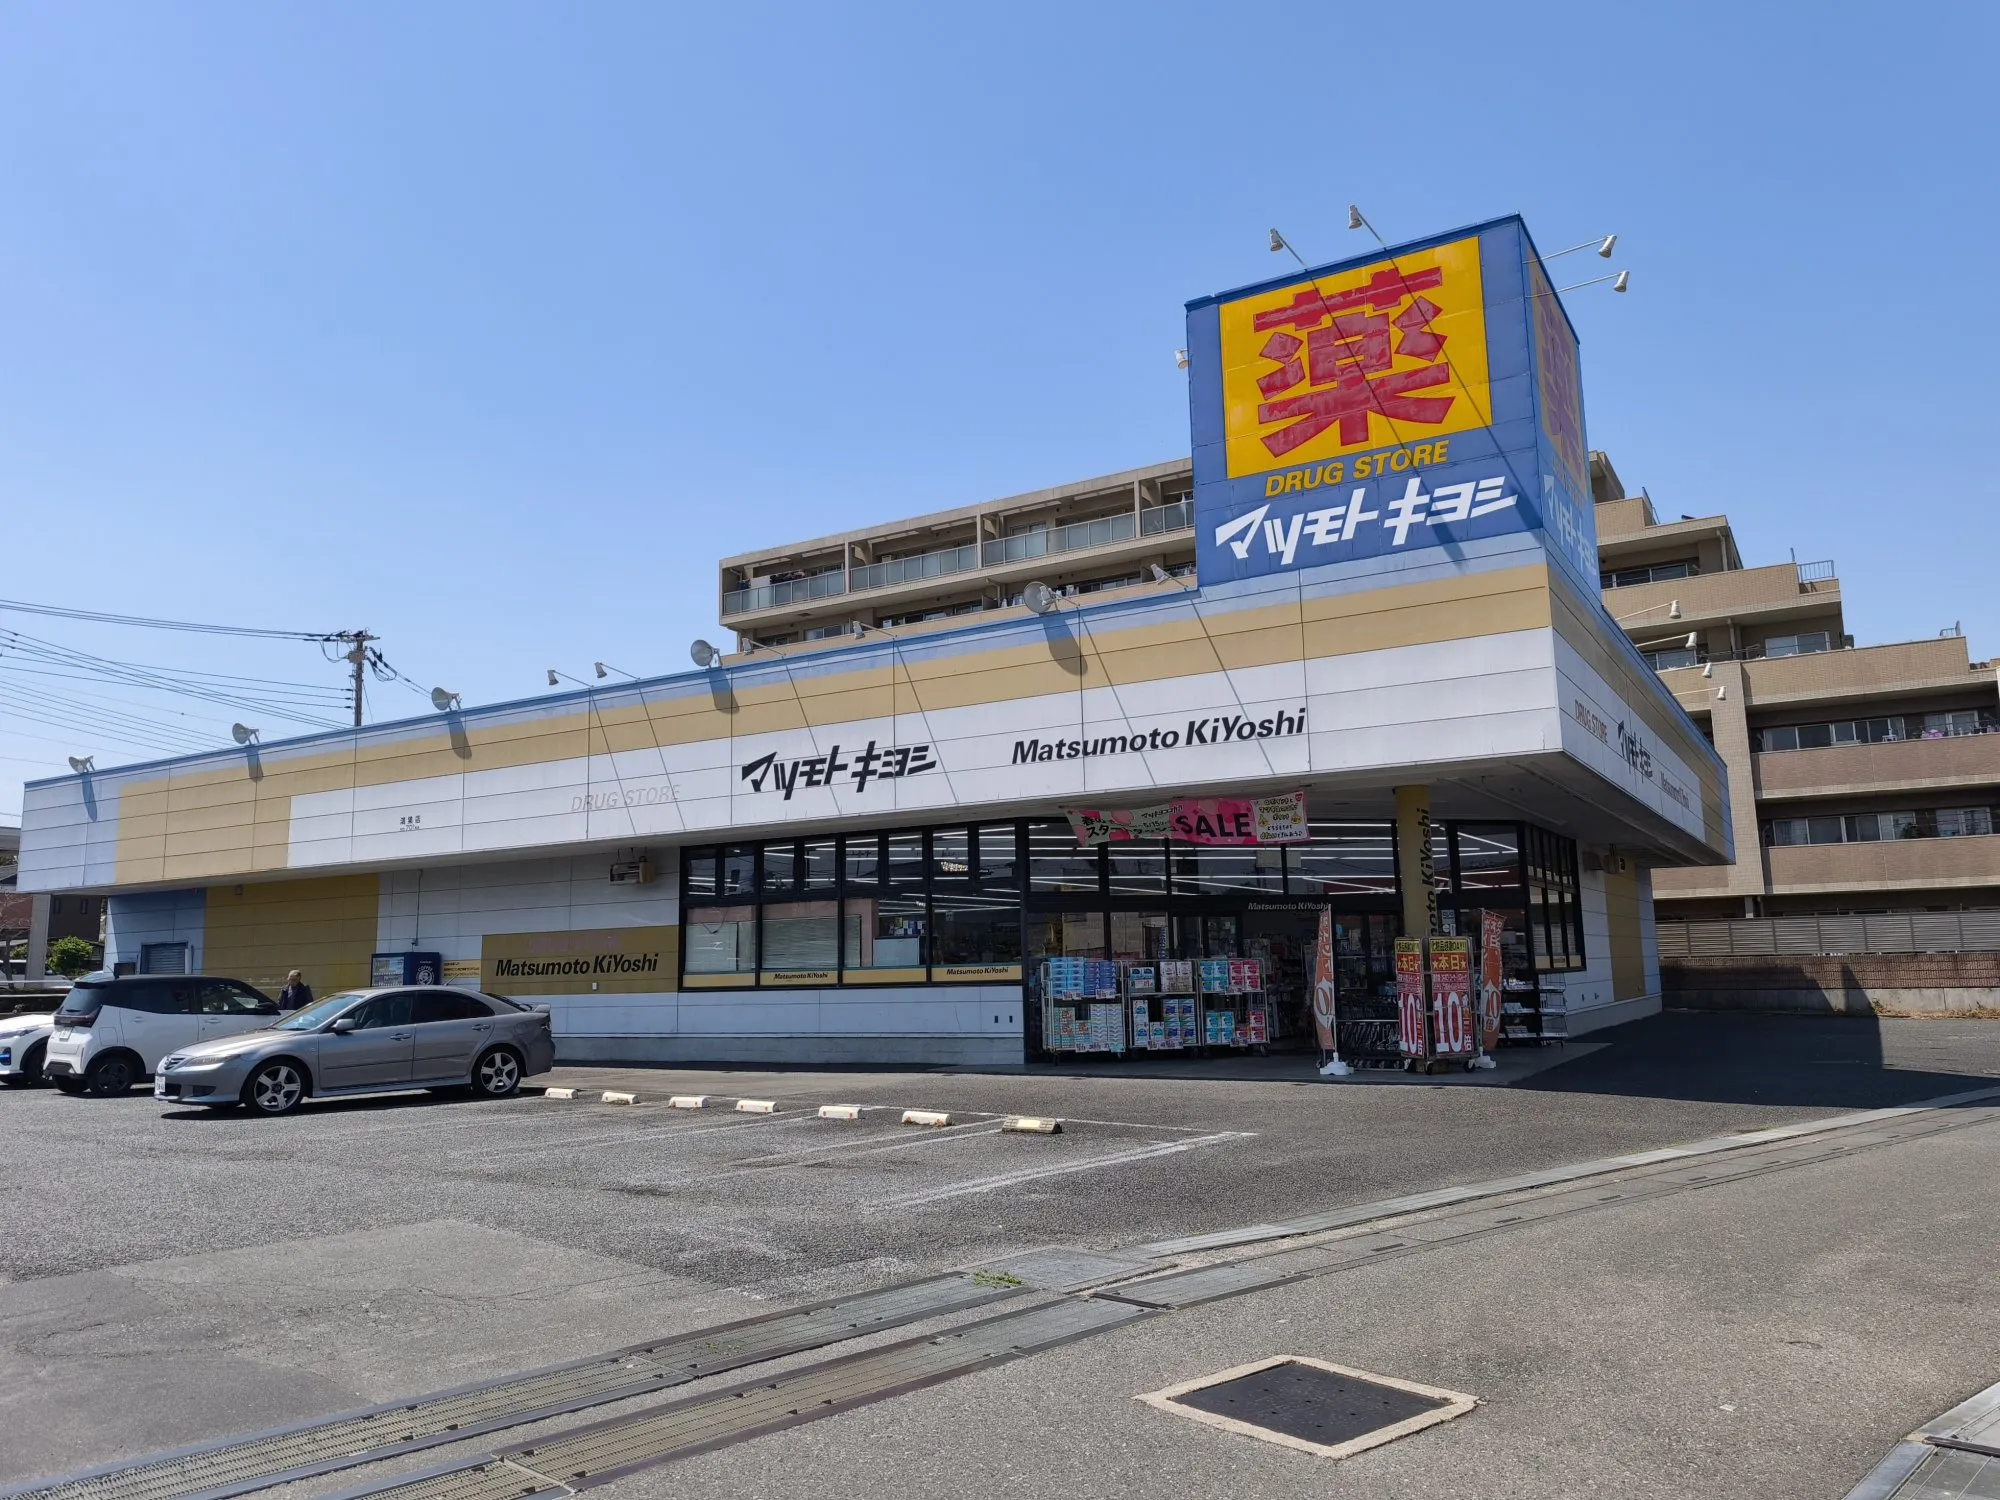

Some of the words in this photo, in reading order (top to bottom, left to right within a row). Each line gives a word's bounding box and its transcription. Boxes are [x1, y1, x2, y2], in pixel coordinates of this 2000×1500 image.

[1254, 266, 1456, 459] 薬
[1265, 462, 1343, 497] DRUG
[1353, 440, 1450, 479] STORE
[1215, 476, 1518, 566] マツモトキヨシ
[1012, 727, 1181, 765] Matsumoto
[1185, 708, 1306, 747] KiYoshi
[571, 790, 618, 812] DRUG
[624, 784, 682, 806] STORE
[742, 740, 937, 800] マツモトキヨシ
[1175, 812, 1252, 837] SALE
[1417, 808, 1434, 885] KiYoshi
[1248, 902, 1297, 910] Matsumoto
[496, 959, 590, 977] Matsumoto
[593, 953, 659, 974] KiYoshi
[773, 972, 807, 981] Matsumoto
[946, 968, 984, 976] Matsumoto
[984, 966, 1009, 974] KiYoshi
[1440, 954, 1460, 970] 本日
[1398, 992, 1418, 1055] 10
[1434, 991, 1462, 1052] 10
